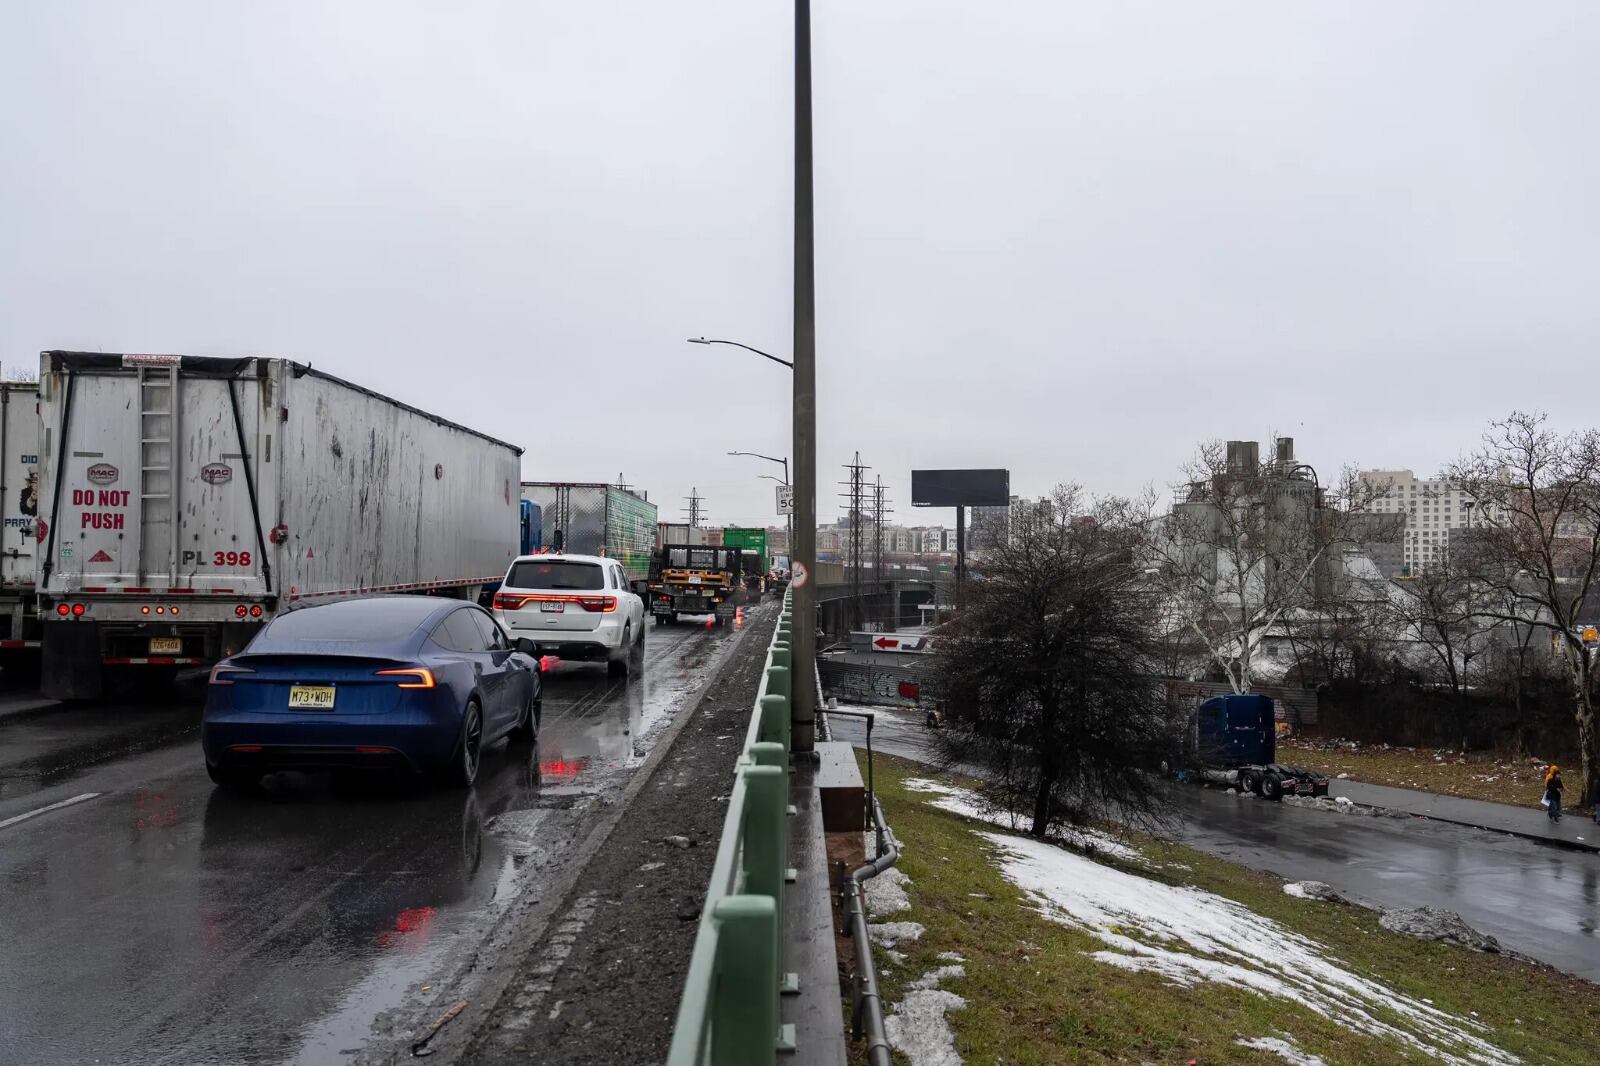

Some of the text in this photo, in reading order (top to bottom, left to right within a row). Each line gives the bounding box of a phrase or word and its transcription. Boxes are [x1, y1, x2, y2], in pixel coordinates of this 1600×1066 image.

[73, 489, 131, 507] DO NOT
[81, 512, 124, 530] PUSH
[182, 550, 251, 567] PL 398
